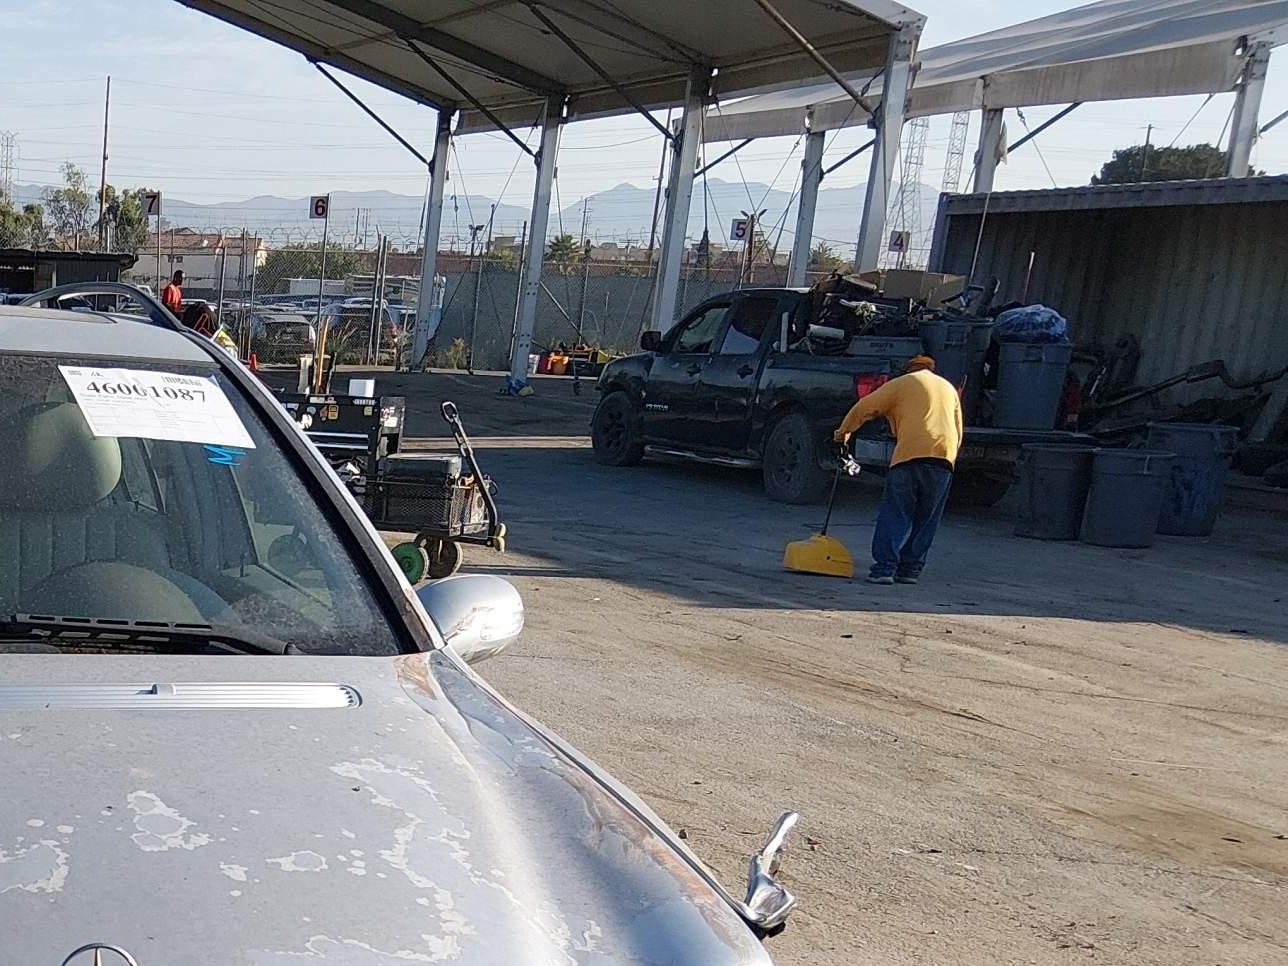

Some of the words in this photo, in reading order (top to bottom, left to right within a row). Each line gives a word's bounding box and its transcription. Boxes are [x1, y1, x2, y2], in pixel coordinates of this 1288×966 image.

[144, 194, 158, 213] 7
[313, 198, 327, 217] 6
[734, 221, 747, 239] 5
[893, 234, 905, 251] 4
